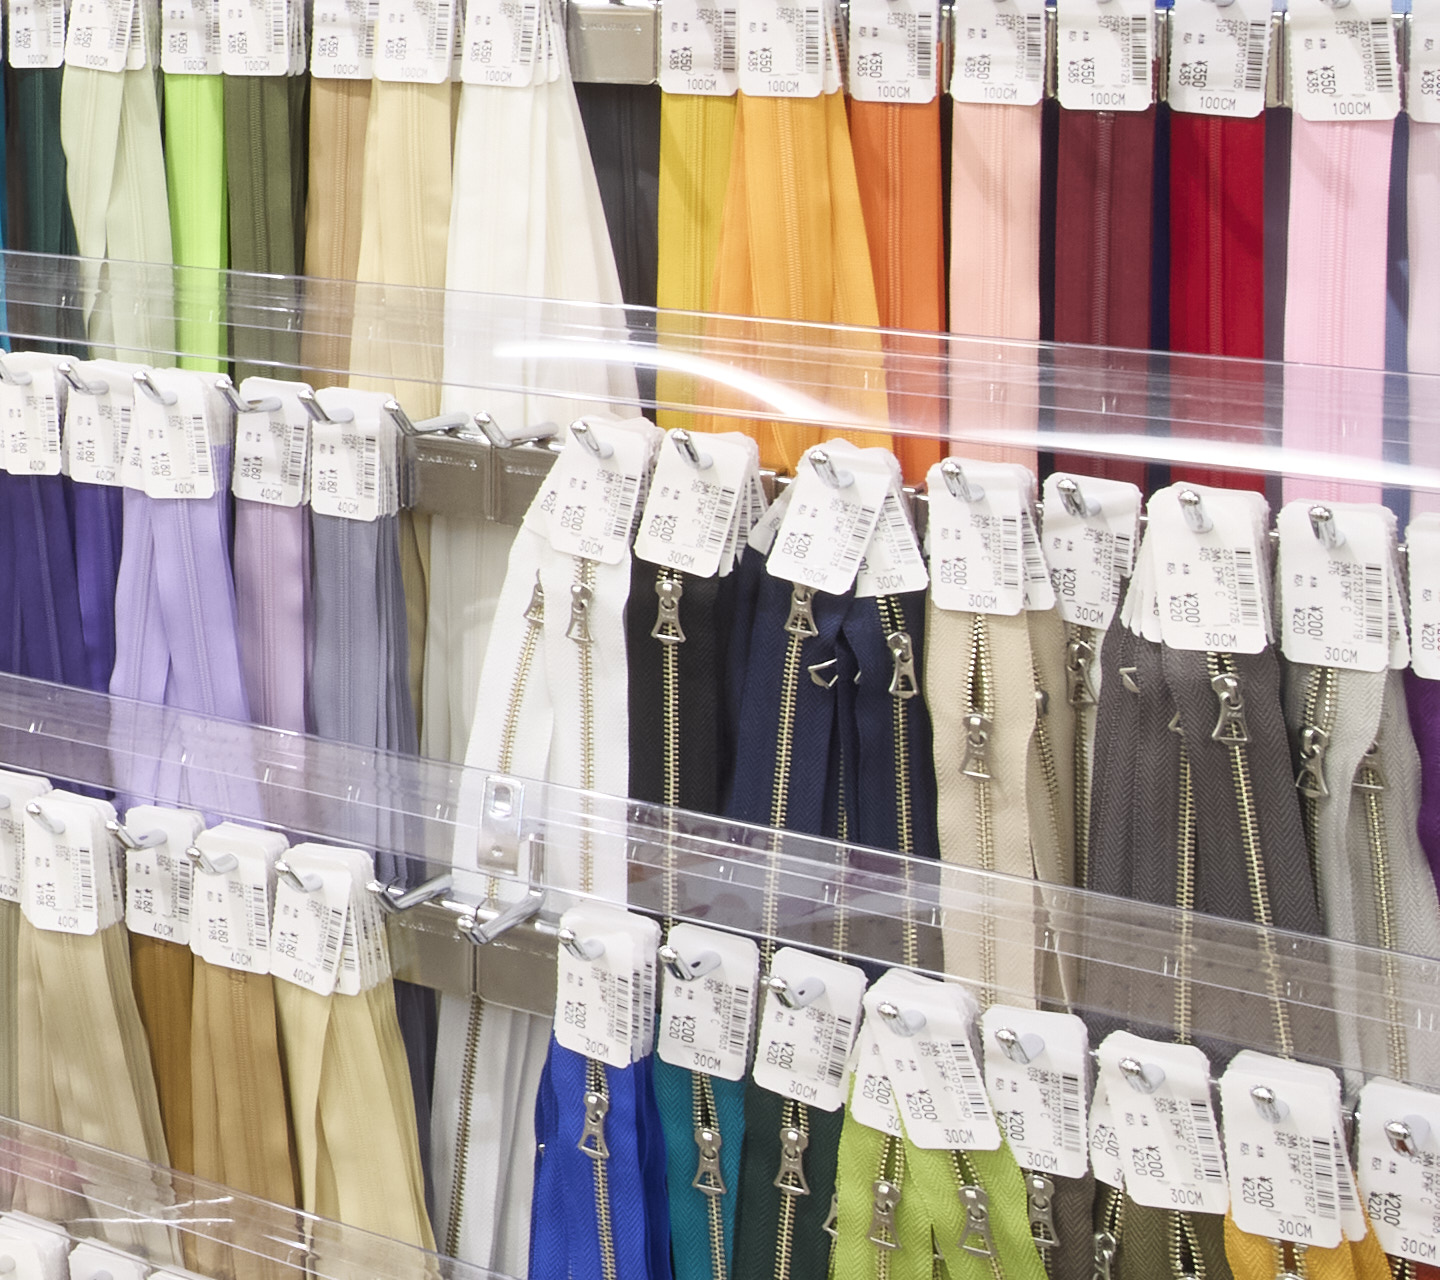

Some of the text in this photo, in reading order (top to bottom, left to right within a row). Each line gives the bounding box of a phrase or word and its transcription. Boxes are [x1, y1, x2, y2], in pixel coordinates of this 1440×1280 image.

[178, 32, 188, 54] ¥350
[237, 31, 248, 54] ¥350
[328, 35, 338, 58] ¥350
[183, 60, 208, 71] 100CM
[244, 60, 270, 71] 100CM
[332, 63, 359, 75] 100CM
[869, 51, 882, 78] ¥350
[1081, 57, 1095, 85] ¥350
[1193, 60, 1208, 88] ¥350
[485, 70, 512, 83] 100CM
[687, 79, 717, 91] 100CM
[1321, 65, 1336, 94] ¥350
[767, 80, 799, 93] 100CM
[877, 86, 911, 98] 100CM
[984, 86, 1017, 99] 100CM
[1090, 92, 1125, 105] 100CM
[1200, 96, 1236, 111] 100CM
[1332, 102, 1371, 115] 100CM
[580, 539, 604, 556] 30CM
[668, 549, 694, 568] 30CM
[953, 557, 968, 586] ¥200
[1062, 568, 1076, 597] ¥200
[968, 594, 998, 609] 30CM
[1183, 591, 1201, 624] ¥200
[1074, 605, 1104, 624] 30CM
[1308, 606, 1323, 637] ¥200
[1204, 632, 1237, 648] 30CM
[1325, 647, 1357, 663] 30CM
[575, 1001, 587, 1029] ¥200
[681, 1015, 697, 1044] ¥200
[585, 1038, 609, 1058] 30CM
[780, 1041, 794, 1070] ¥200
[693, 1052, 721, 1070] 30CM
[788, 1080, 818, 1101] 30CM
[918, 1089, 938, 1121] ¥200
[1010, 1110, 1025, 1141] ¥200
[945, 1128, 975, 1144] 30CM
[1027, 1151, 1059, 1170] 30CM
[1146, 1145, 1165, 1179] ¥200
[1169, 1188, 1204, 1206] 30CM
[1256, 1176, 1276, 1209] ¥200
[1382, 1191, 1401, 1227] ¥200
[1278, 1221, 1313, 1239] 30CM
[1401, 1236, 1437, 1259] 30CM
